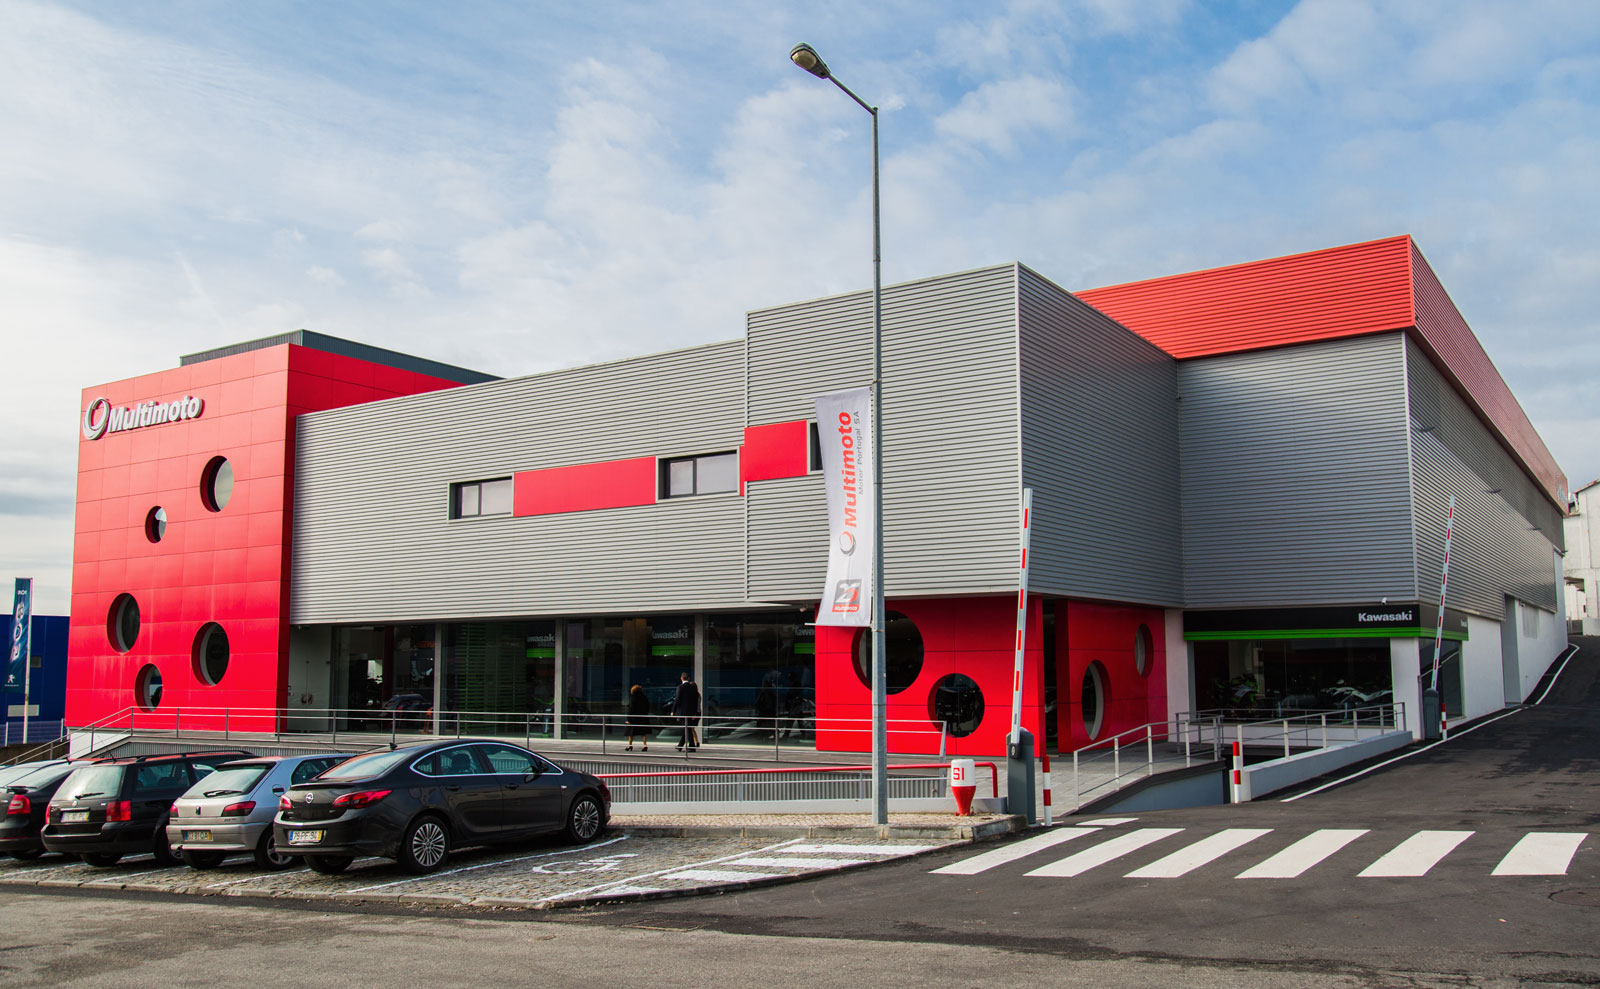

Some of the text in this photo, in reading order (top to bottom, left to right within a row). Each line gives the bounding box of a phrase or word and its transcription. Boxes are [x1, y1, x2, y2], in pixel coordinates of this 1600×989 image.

[106, 395, 204, 433] Multimoto
[853, 411, 860, 425] SA
[855, 428, 863, 465] Portugal
[838, 411, 857, 528] Multimoto
[1358, 611, 1413, 622] Kawasaki
